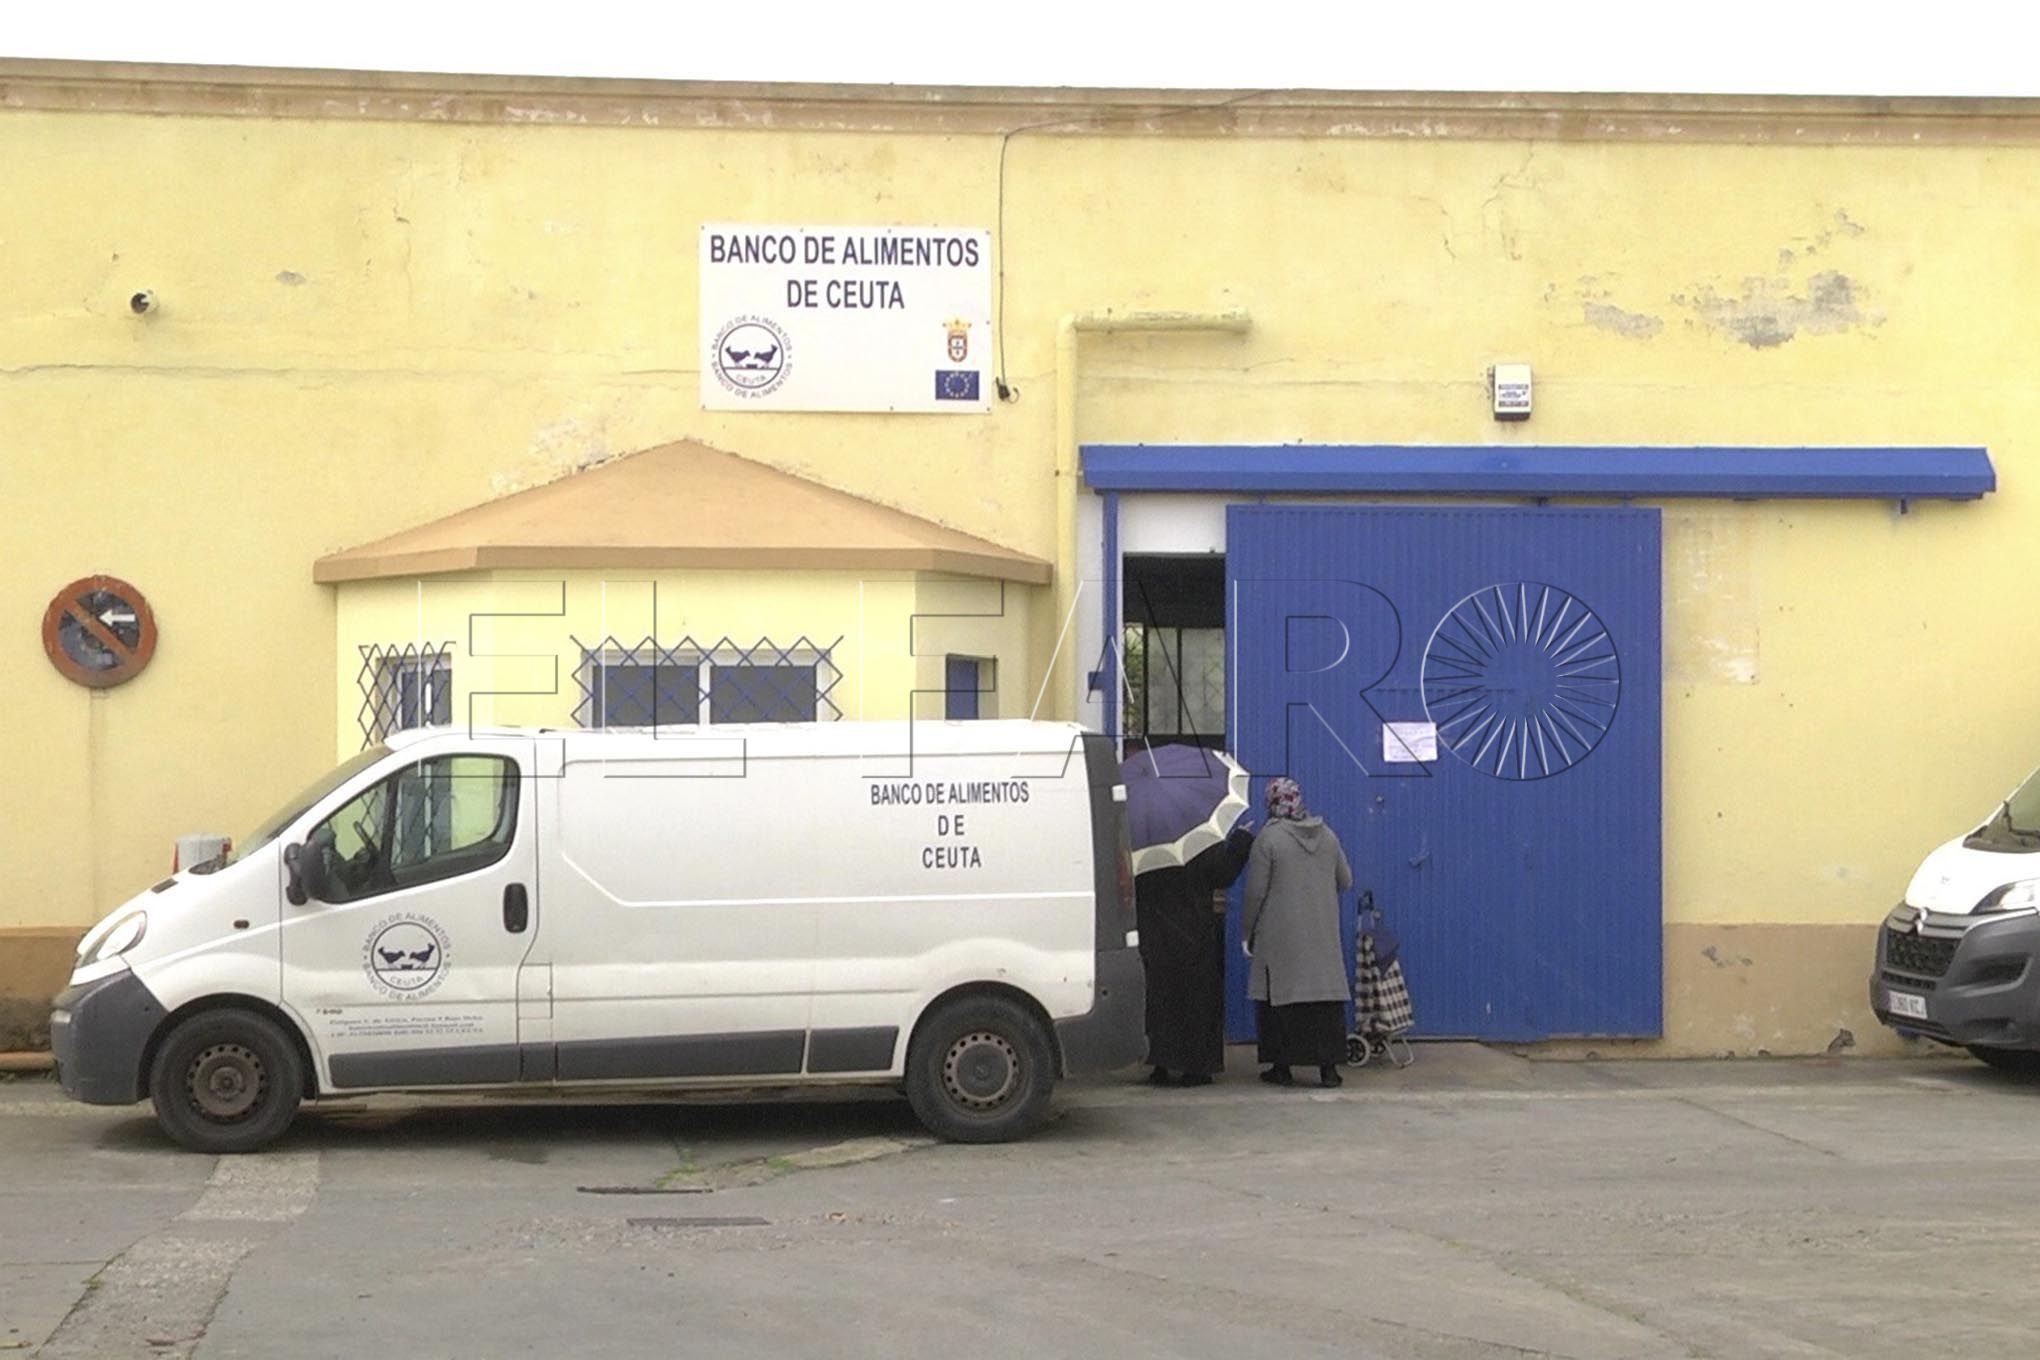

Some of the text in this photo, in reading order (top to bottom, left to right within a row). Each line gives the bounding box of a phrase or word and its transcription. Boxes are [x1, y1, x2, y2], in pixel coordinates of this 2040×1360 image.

[710, 235, 979, 267] BANCO DE ALIMENTOS
[787, 279, 905, 309] DE CEUTA
[711, 320, 734, 350] BANCO
[751, 314, 793, 351] ALIMENTOS
[711, 361, 734, 392] BANCO
[751, 363, 793, 399] ALIMENTOS
[871, 781, 1030, 805] BANCO DE ALIMENTOS
[938, 815, 965, 836] DE
[922, 846, 982, 869] CEUTA
[362, 920, 387, 952] BANCO
[405, 912, 452, 950] ALIMENTOS
[362, 963, 388, 995] BANCO
[405, 962, 452, 1000] ALIMENTOS
[390, 975, 424, 986] CEUTA
